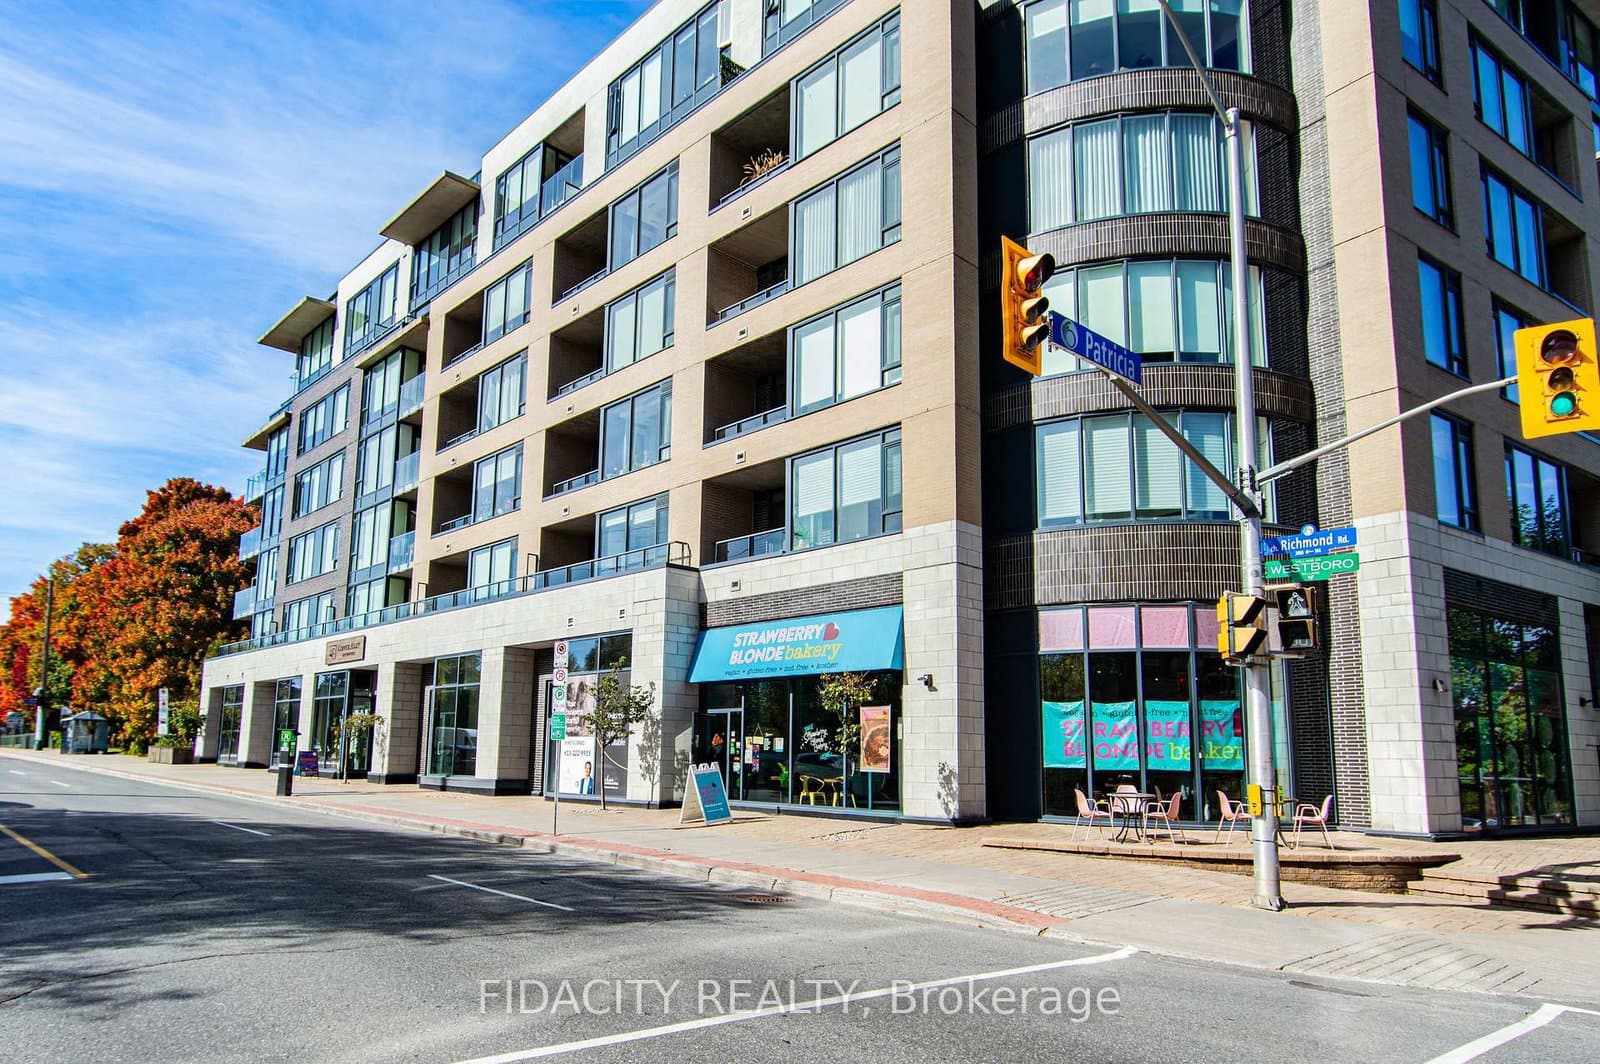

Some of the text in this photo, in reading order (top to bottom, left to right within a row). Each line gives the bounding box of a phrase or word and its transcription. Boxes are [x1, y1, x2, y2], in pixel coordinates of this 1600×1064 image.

[1085, 331, 1135, 380] Patricia
[1280, 533, 1333, 551] Richmond
[1337, 535, 1350, 544] Rd.
[1270, 558, 1354, 575] WESTBORO
[733, 623, 824, 648] STRAWBERRY
[729, 643, 845, 665] BLONDE bakery
